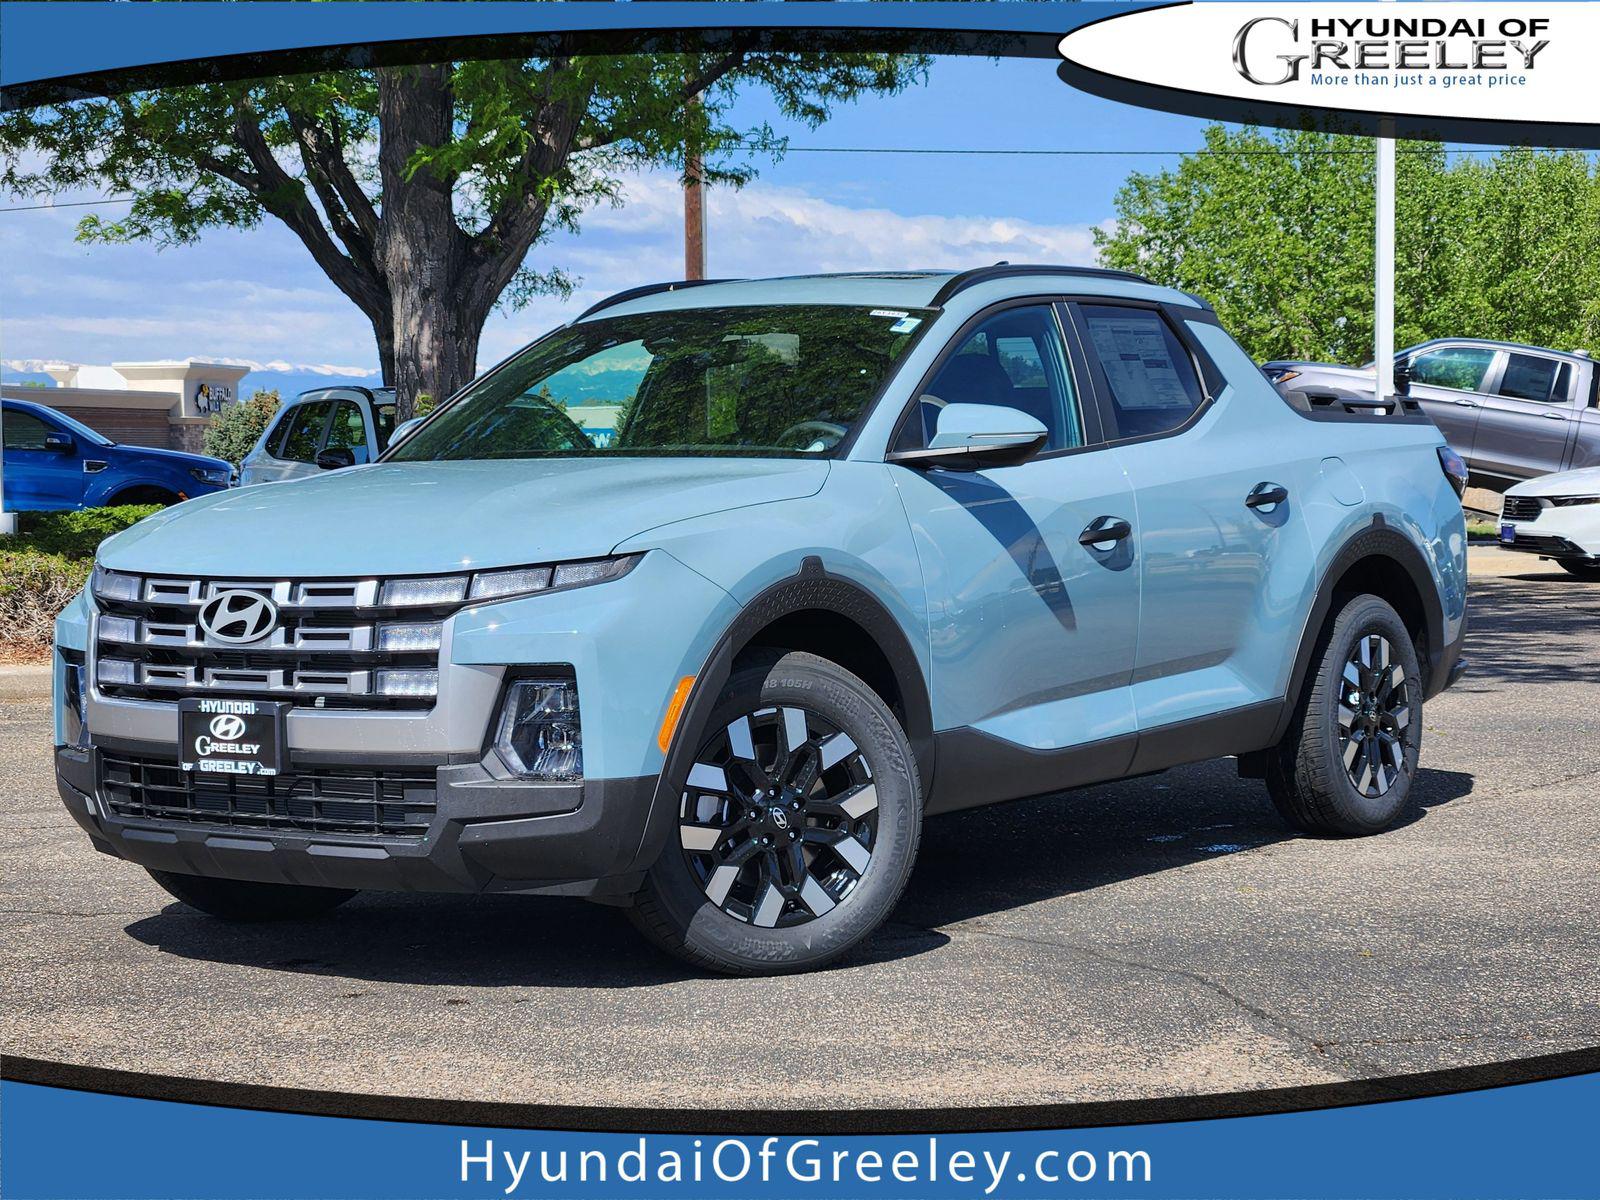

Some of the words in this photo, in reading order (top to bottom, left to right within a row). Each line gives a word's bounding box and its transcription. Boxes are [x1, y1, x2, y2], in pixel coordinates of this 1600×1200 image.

[201, 701, 255, 714] HYUNDAI
[195, 736, 260, 756] GREELEY
[182, 763, 194, 771] OF
